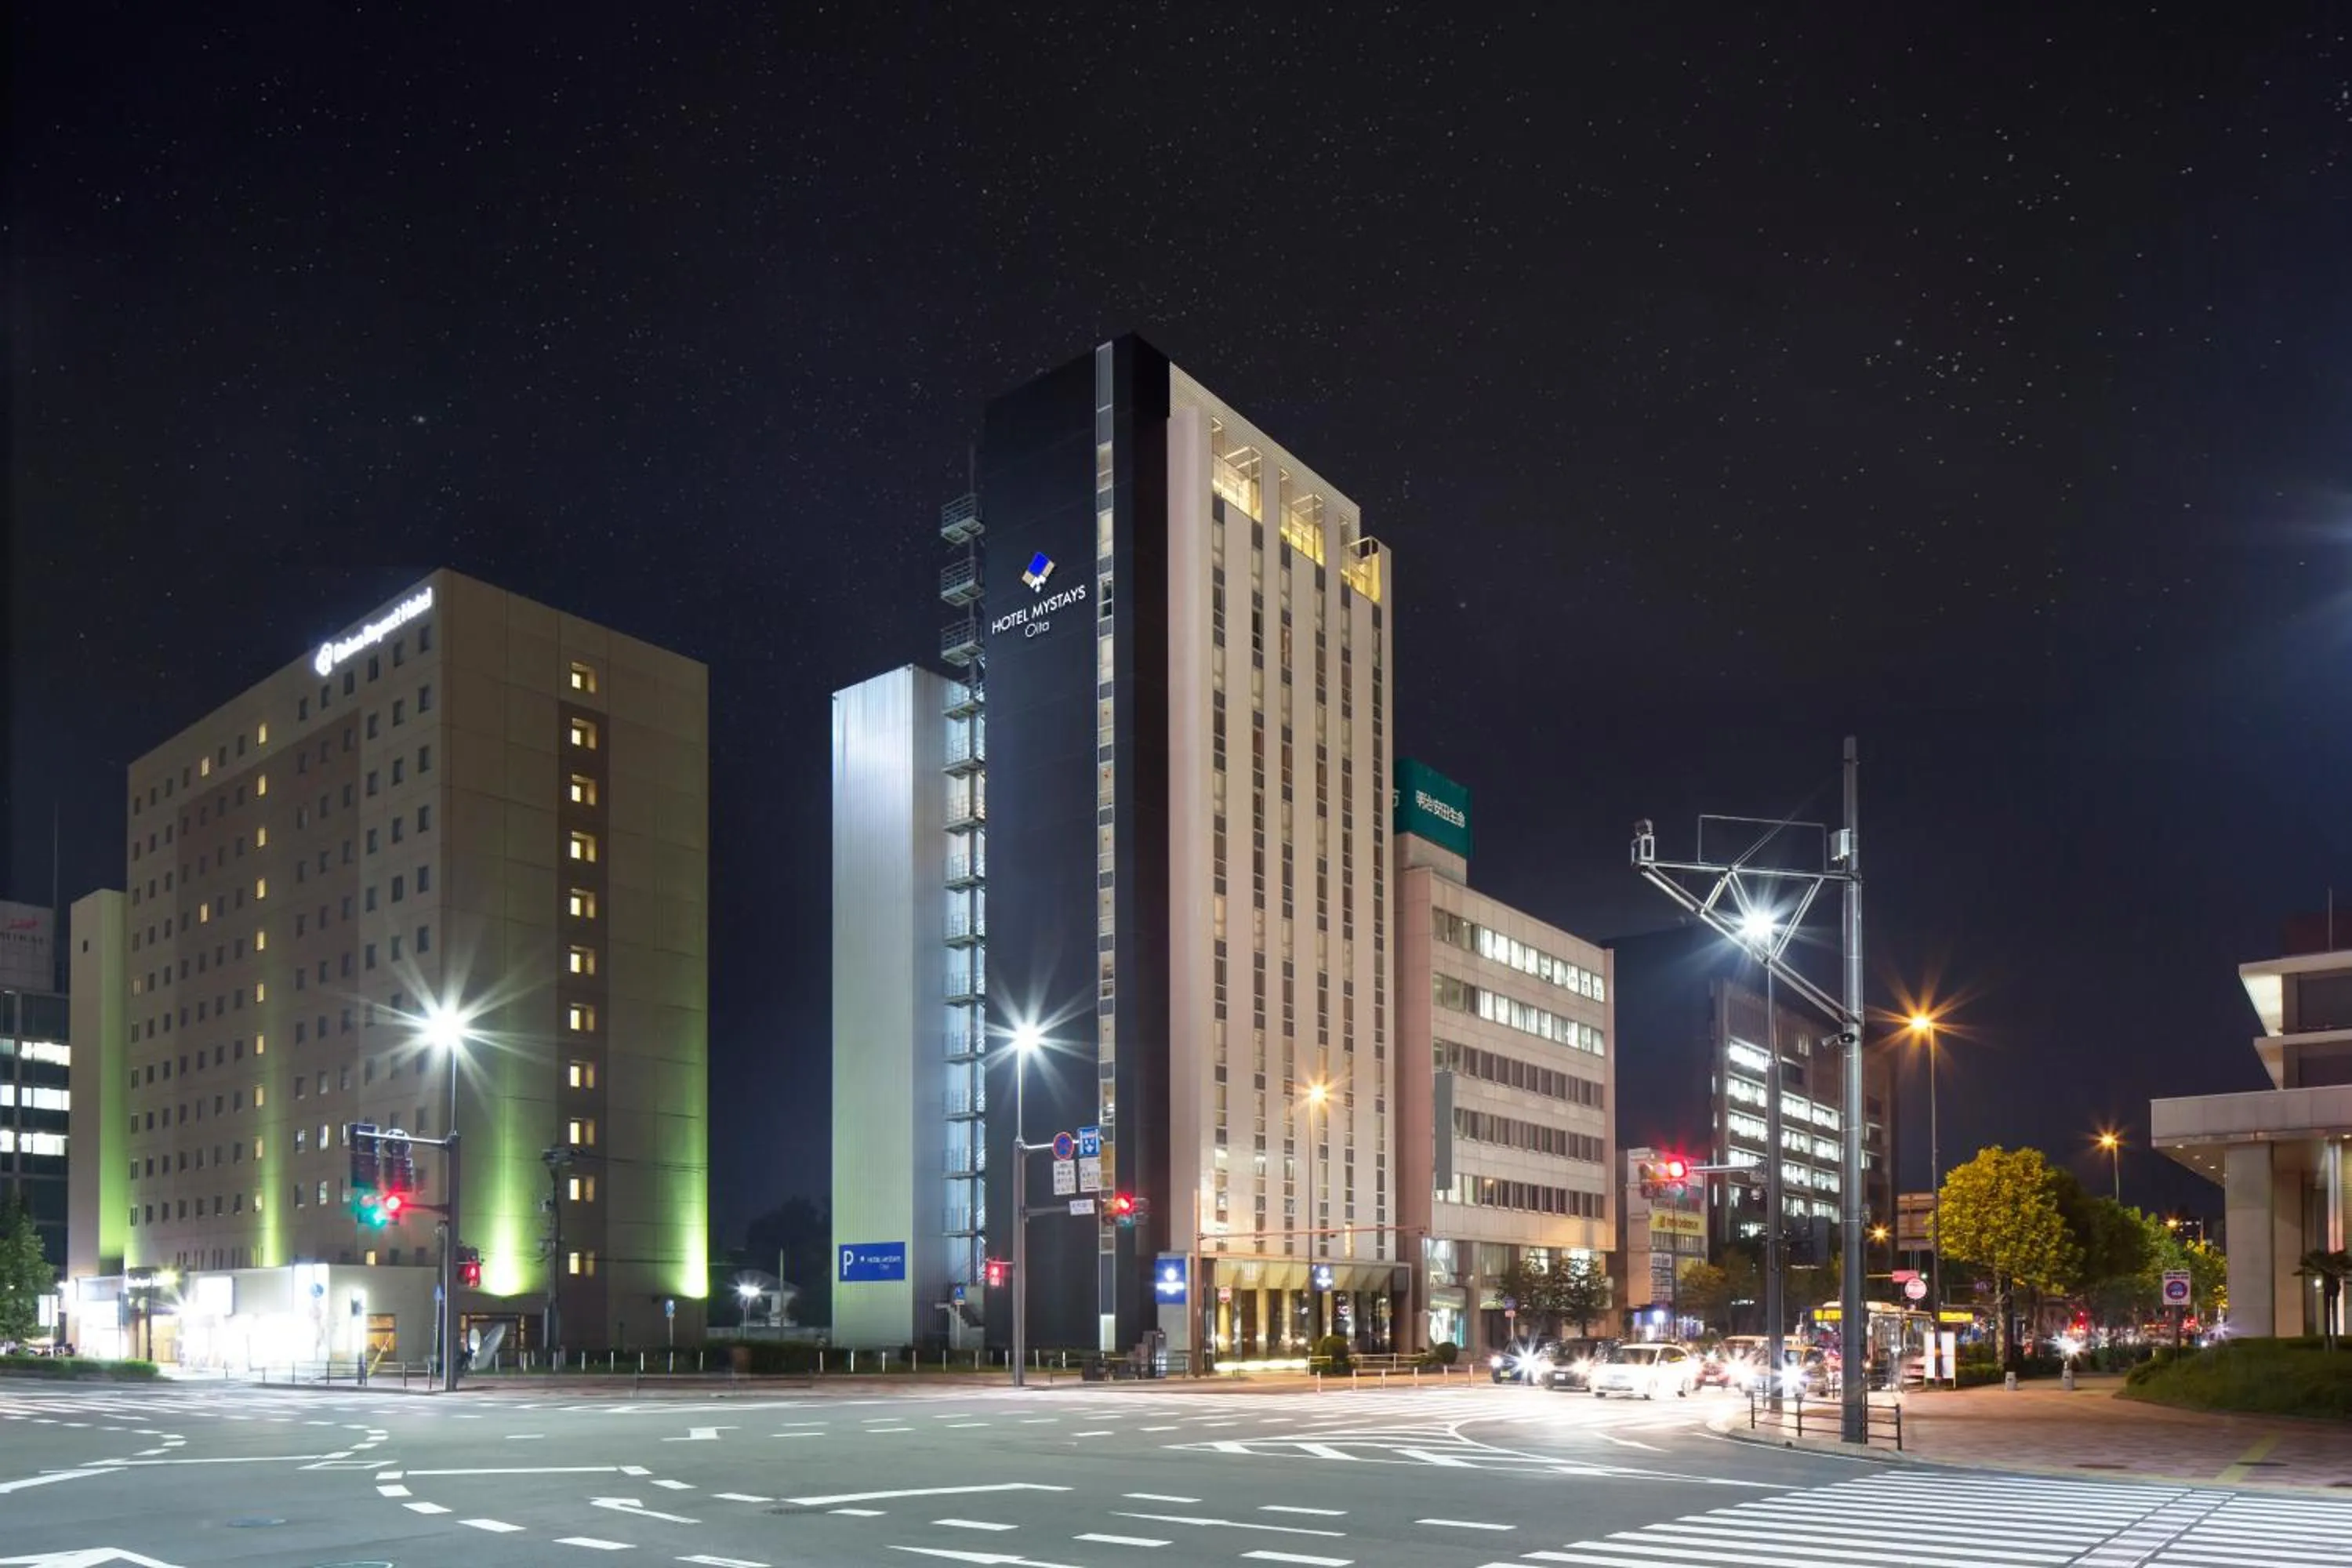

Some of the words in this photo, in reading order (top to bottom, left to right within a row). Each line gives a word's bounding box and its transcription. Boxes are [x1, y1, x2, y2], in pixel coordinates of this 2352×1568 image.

[992, 608, 1029, 634] HOTEL
[1032, 585, 1086, 619] MYSTAYS
[1025, 621, 1050, 637] Oita
[843, 1250, 854, 1276] P
